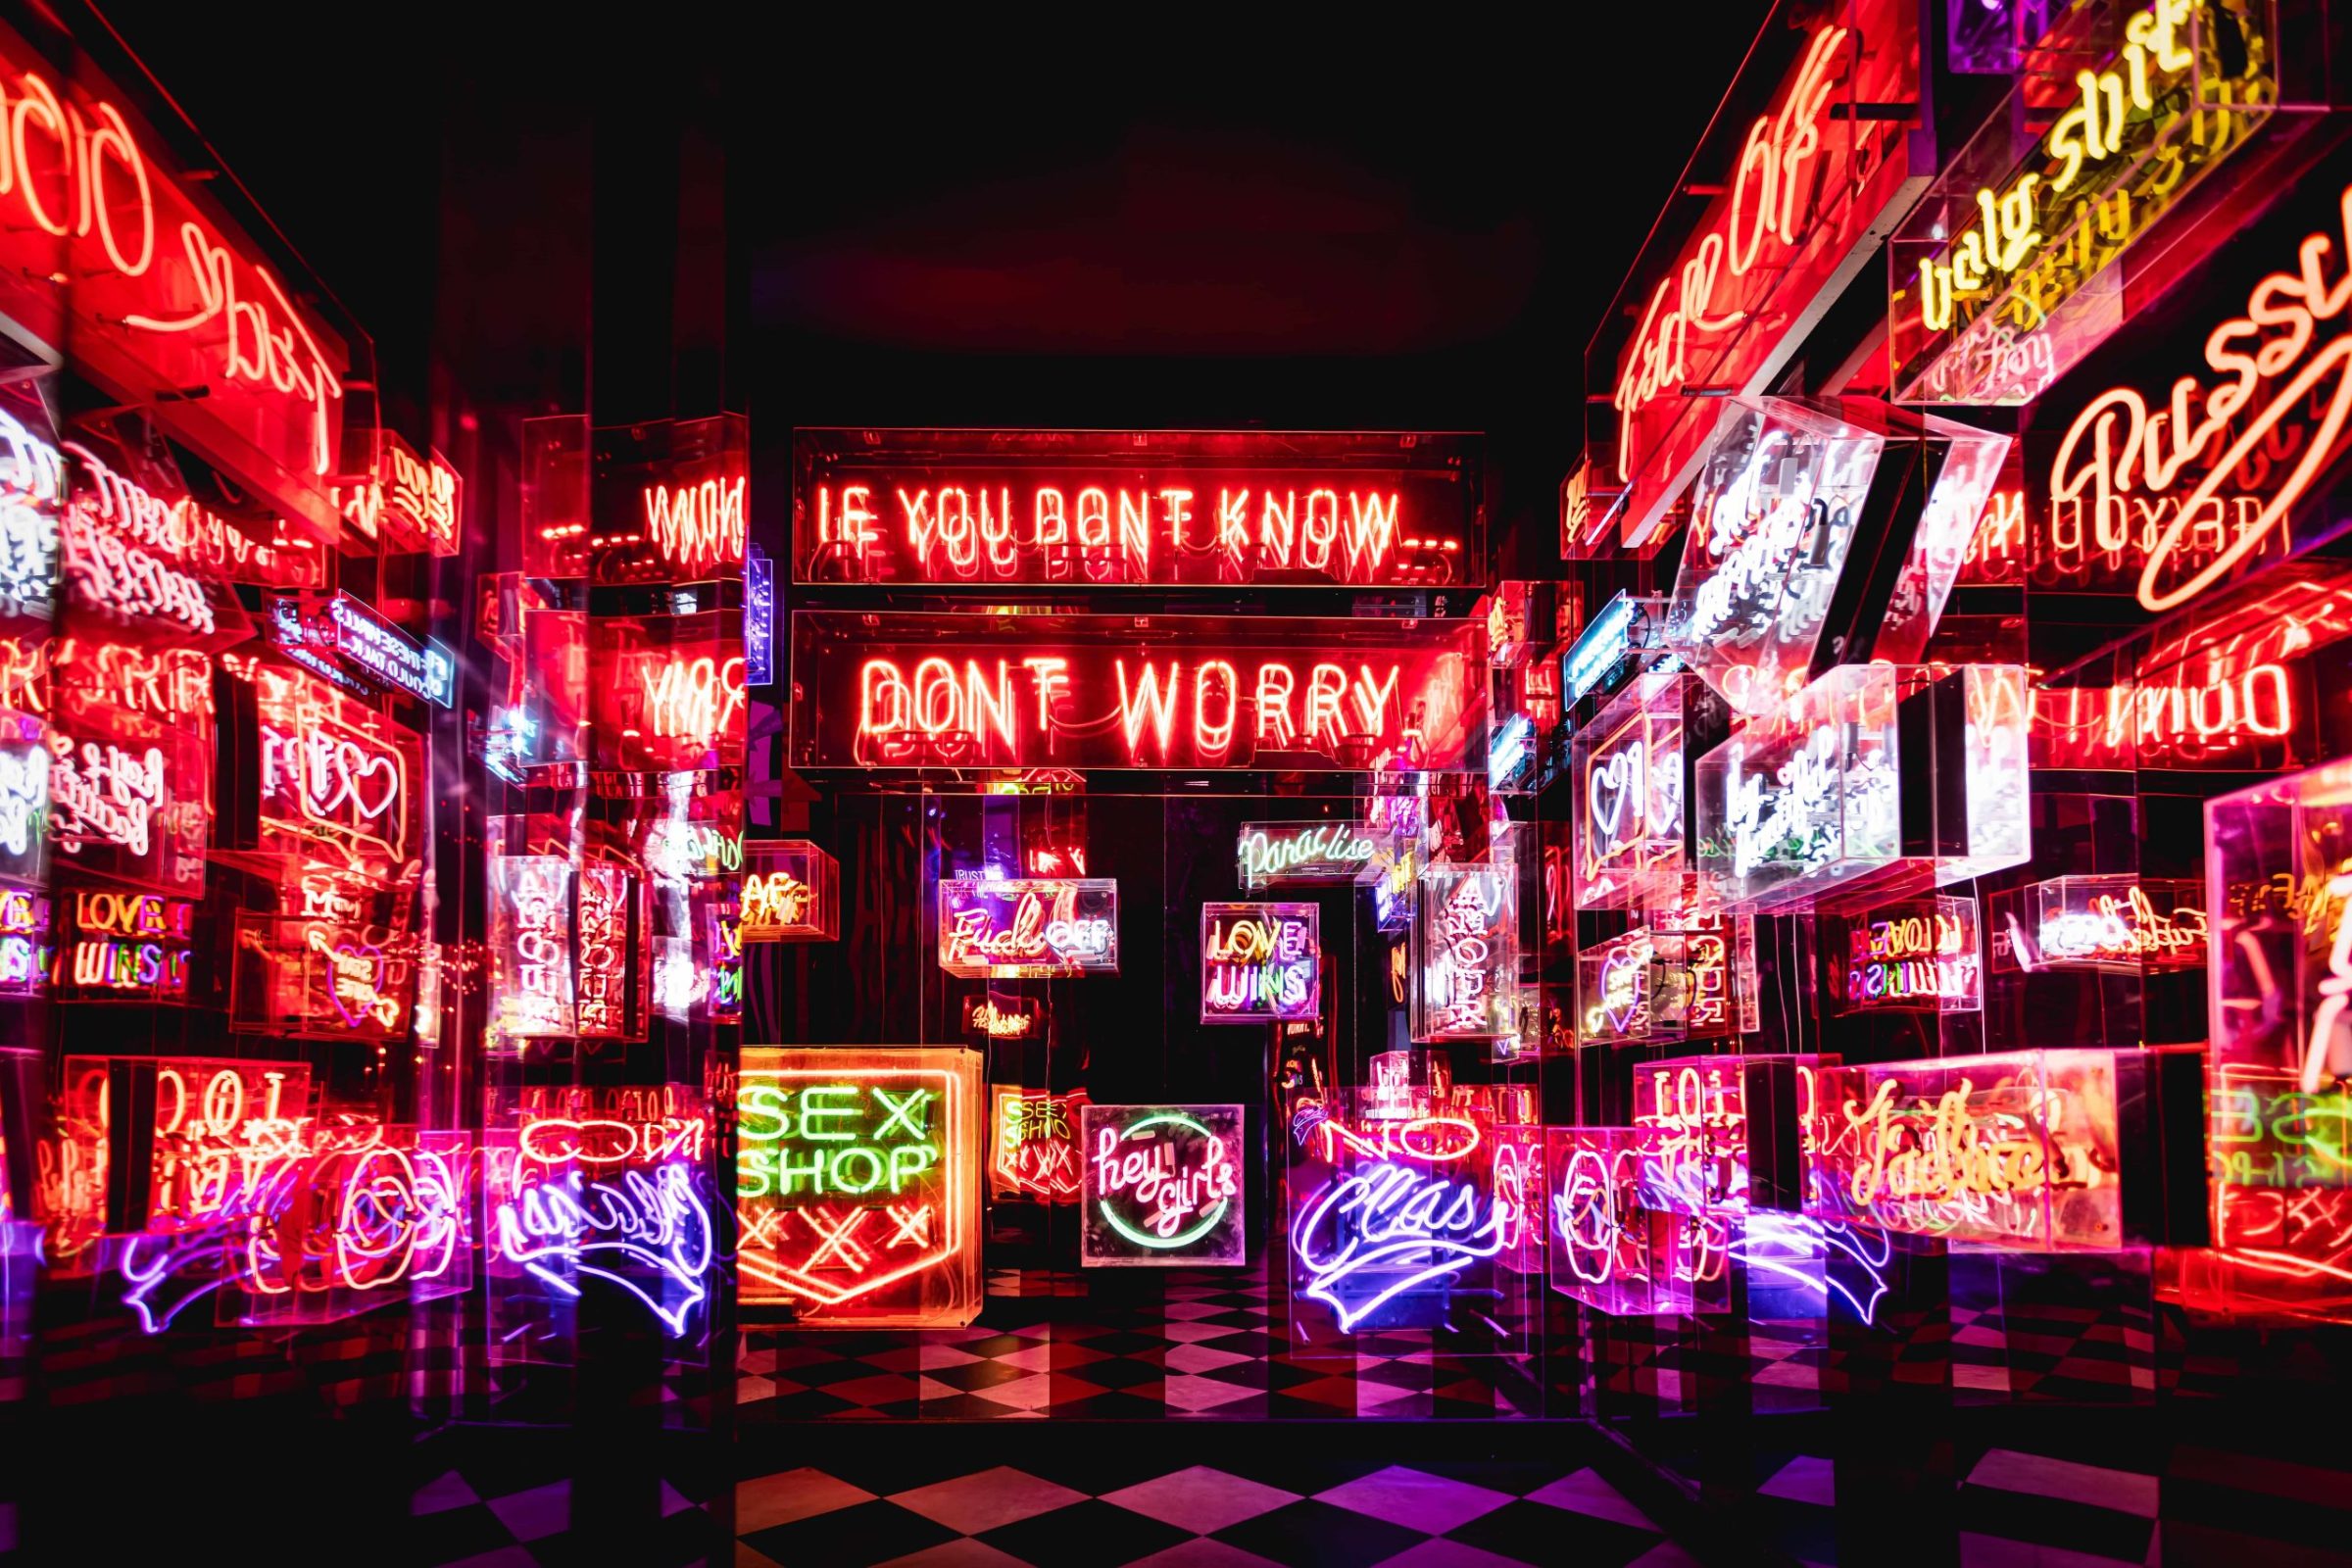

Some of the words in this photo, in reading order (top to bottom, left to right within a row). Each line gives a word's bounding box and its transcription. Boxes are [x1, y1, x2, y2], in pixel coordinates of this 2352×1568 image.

[819, 487, 876, 560] IF
[899, 487, 1016, 564] YOU
[862, 659, 1067, 753] DONT
[1238, 823, 1376, 890] Paradise
[77, 892, 165, 933] LOVE
[948, 891, 1049, 960] Fuck
[1214, 917, 1304, 958] LOVE
[74, 941, 163, 986] WINS
[1213, 964, 1307, 1009] WINS
[737, 1085, 926, 1142] SEX
[1319, 1116, 1481, 1164] NO
[737, 1146, 936, 1198] SHOP
[1092, 1127, 1171, 1203] hey
[1156, 1135, 1238, 1238] girls
